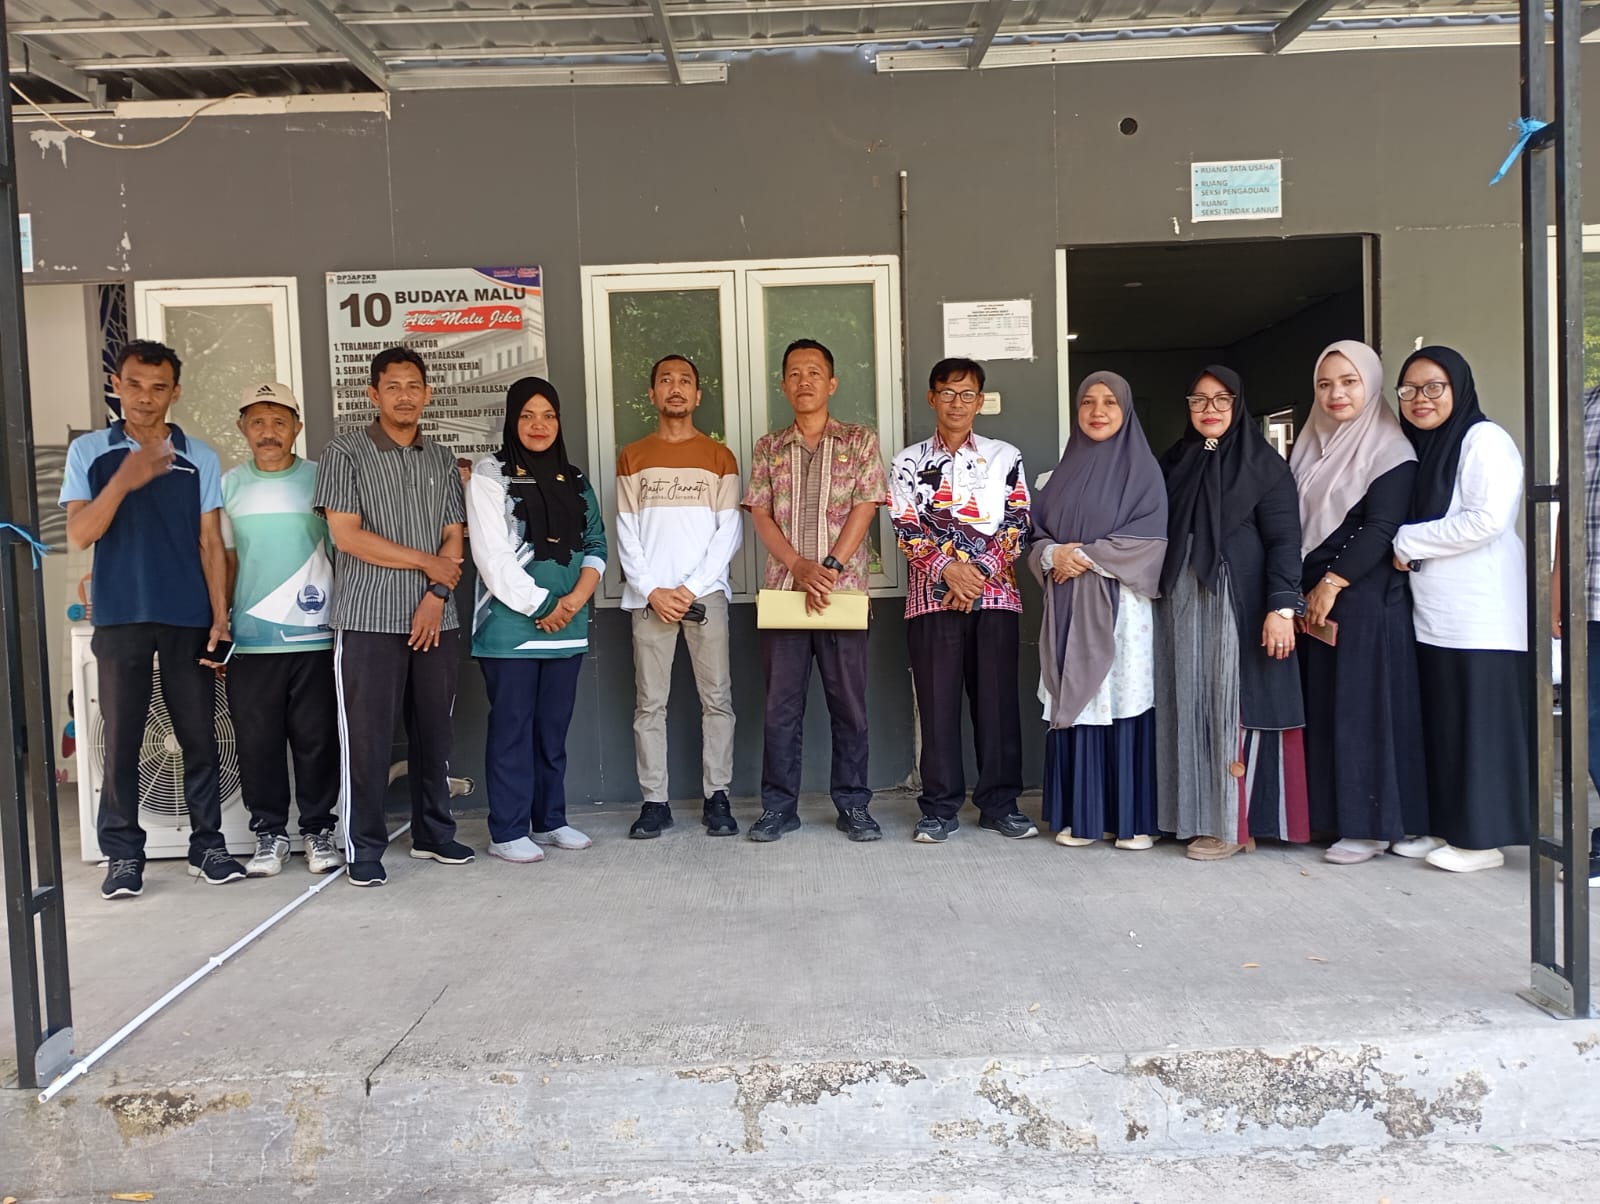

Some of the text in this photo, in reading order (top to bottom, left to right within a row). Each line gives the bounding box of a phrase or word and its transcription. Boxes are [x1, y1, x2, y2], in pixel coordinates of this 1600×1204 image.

[1201, 166, 1228, 174] RUANG
[1248, 163, 1275, 171] USAHA
[1201, 186, 1270, 197] SEKSI PENGADUAN
[1201, 206, 1279, 217] SEKSI TINDAK LANJUT
[395, 287, 526, 304] BUDAYA MALU
[339, 292, 392, 328] 10
[404, 309, 521, 328] Aku Malu Jika
[341, 341, 381, 352] TERLAMBAT
[409, 339, 438, 349] KANTOR
[342, 353, 365, 363] TIDAK
[438, 350, 465, 360] ALASAN
[335, 366, 342, 375] 3.
[343, 366, 369, 375] SERING
[431, 363, 457, 372] MASUK
[458, 361, 480, 371] KERJA
[431, 386, 457, 395] ANTOR
[458, 385, 480, 395] TANPA
[437, 398, 458, 407] KERJA
[345, 413, 367, 422] TIDAK
[421, 409, 445, 419] AWAB
[446, 409, 482, 419] TERHADAP
[442, 433, 460, 442] RAPI
[454, 444, 476, 454] TIDAK
[475, 443, 500, 453] SOPAN
